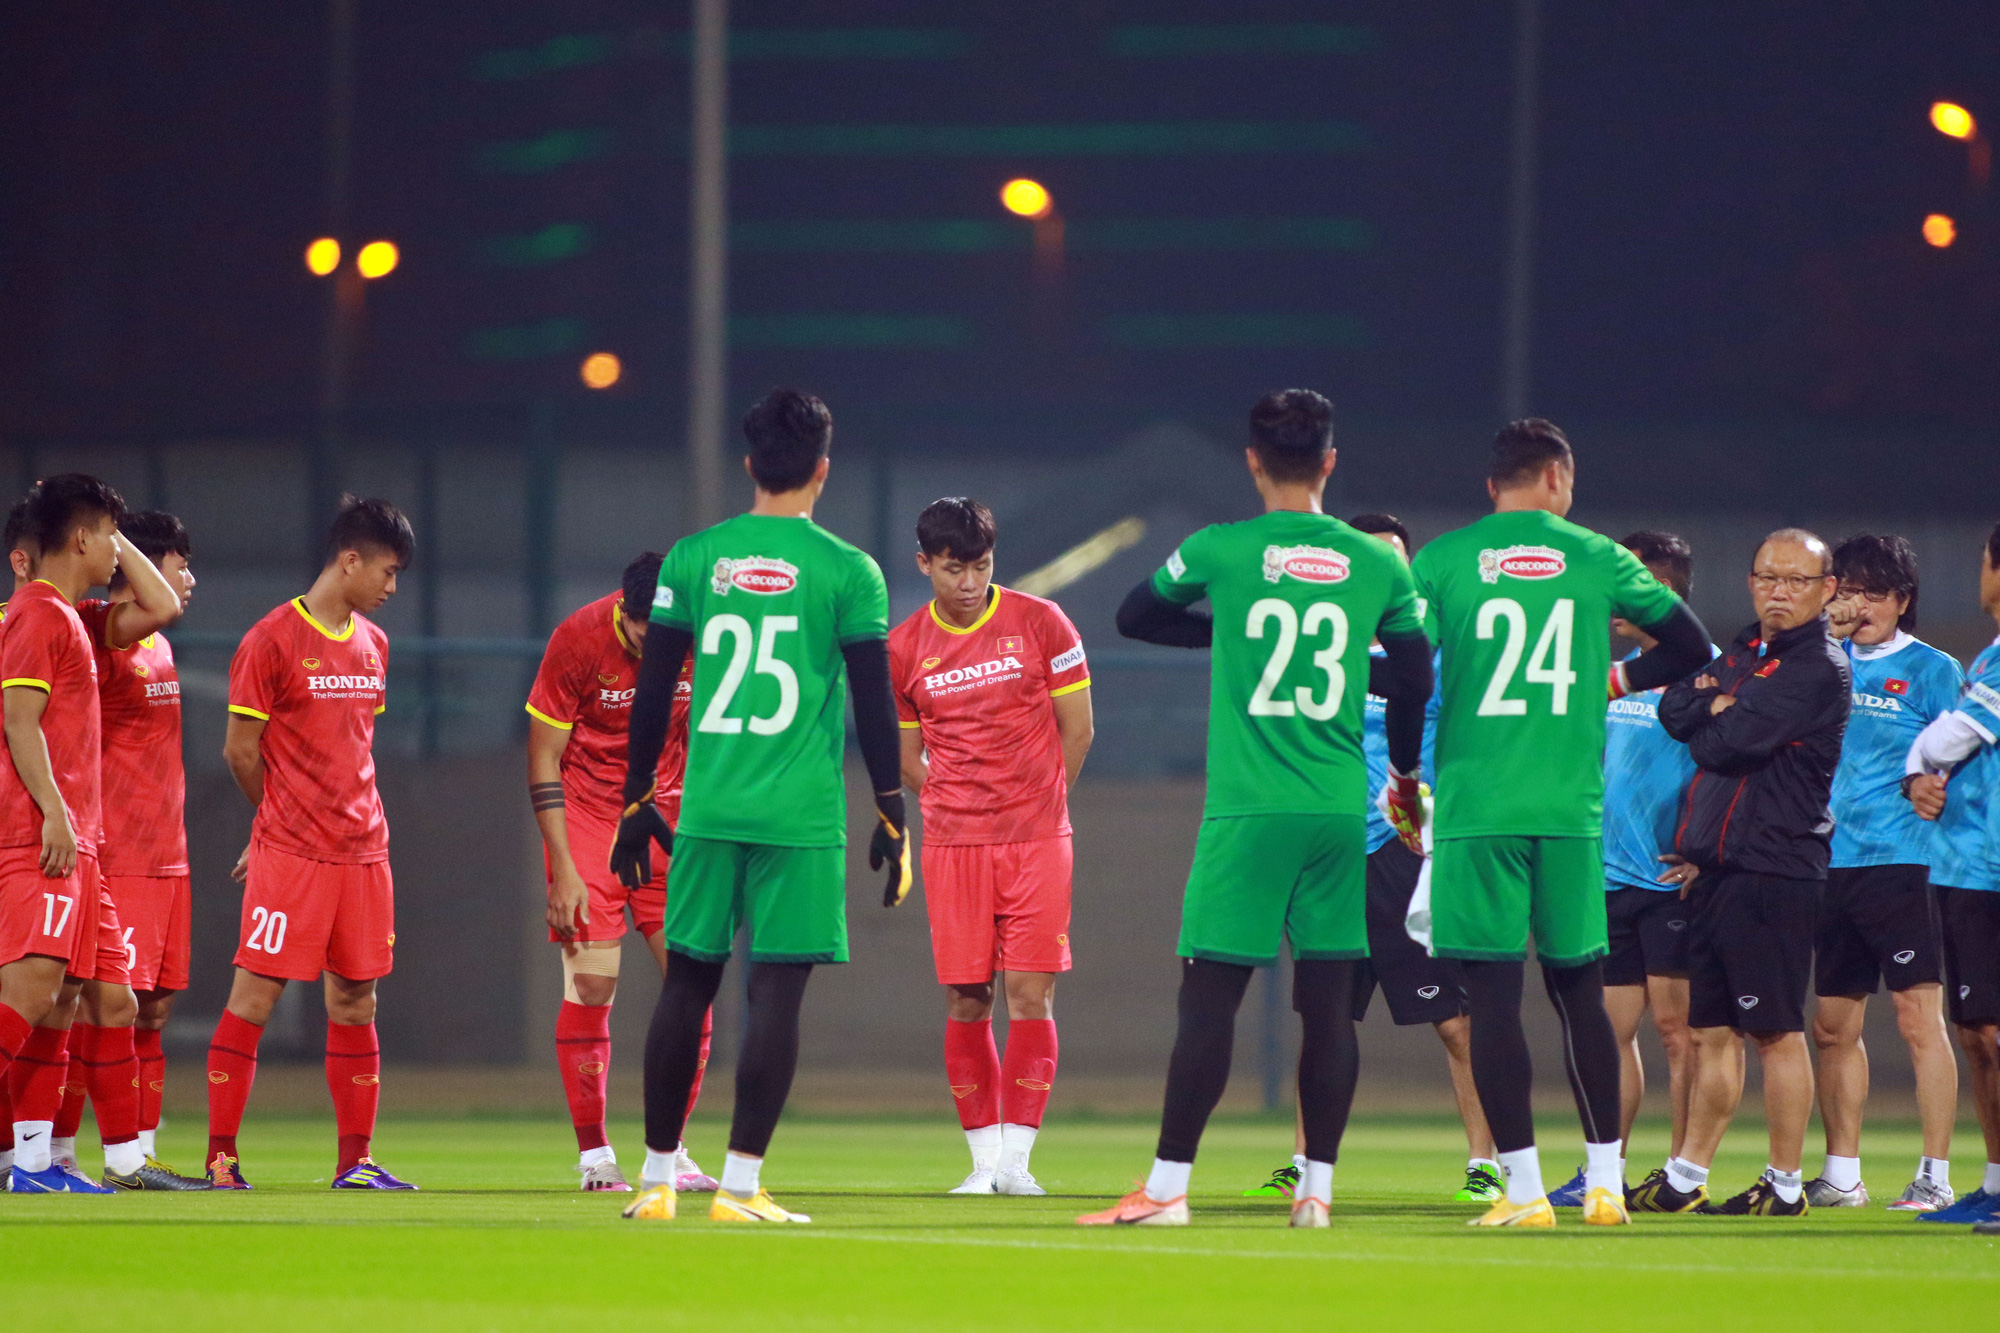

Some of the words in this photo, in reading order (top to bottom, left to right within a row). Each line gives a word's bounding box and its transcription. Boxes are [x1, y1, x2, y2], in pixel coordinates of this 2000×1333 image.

[1245, 598, 1349, 721] 23
[1475, 597, 1577, 717] 24
[306, 675, 381, 690] HONDA
[698, 613, 800, 735] 25
[923, 656, 1024, 690] HONDA
[929, 690, 947, 698] The
[948, 683, 976, 694] Power
[977, 679, 987, 688] of
[988, 672, 1022, 685] Dreams
[144, 681, 180, 697] HOND
[312, 691, 327, 699] The
[327, 691, 348, 699] Power
[348, 691, 357, 699] of
[356, 691, 378, 699] Dream
[1852, 692, 1902, 712] NDA
[602, 702, 619, 710] The
[43, 892, 74, 938] 17
[245, 906, 288, 954] 20
